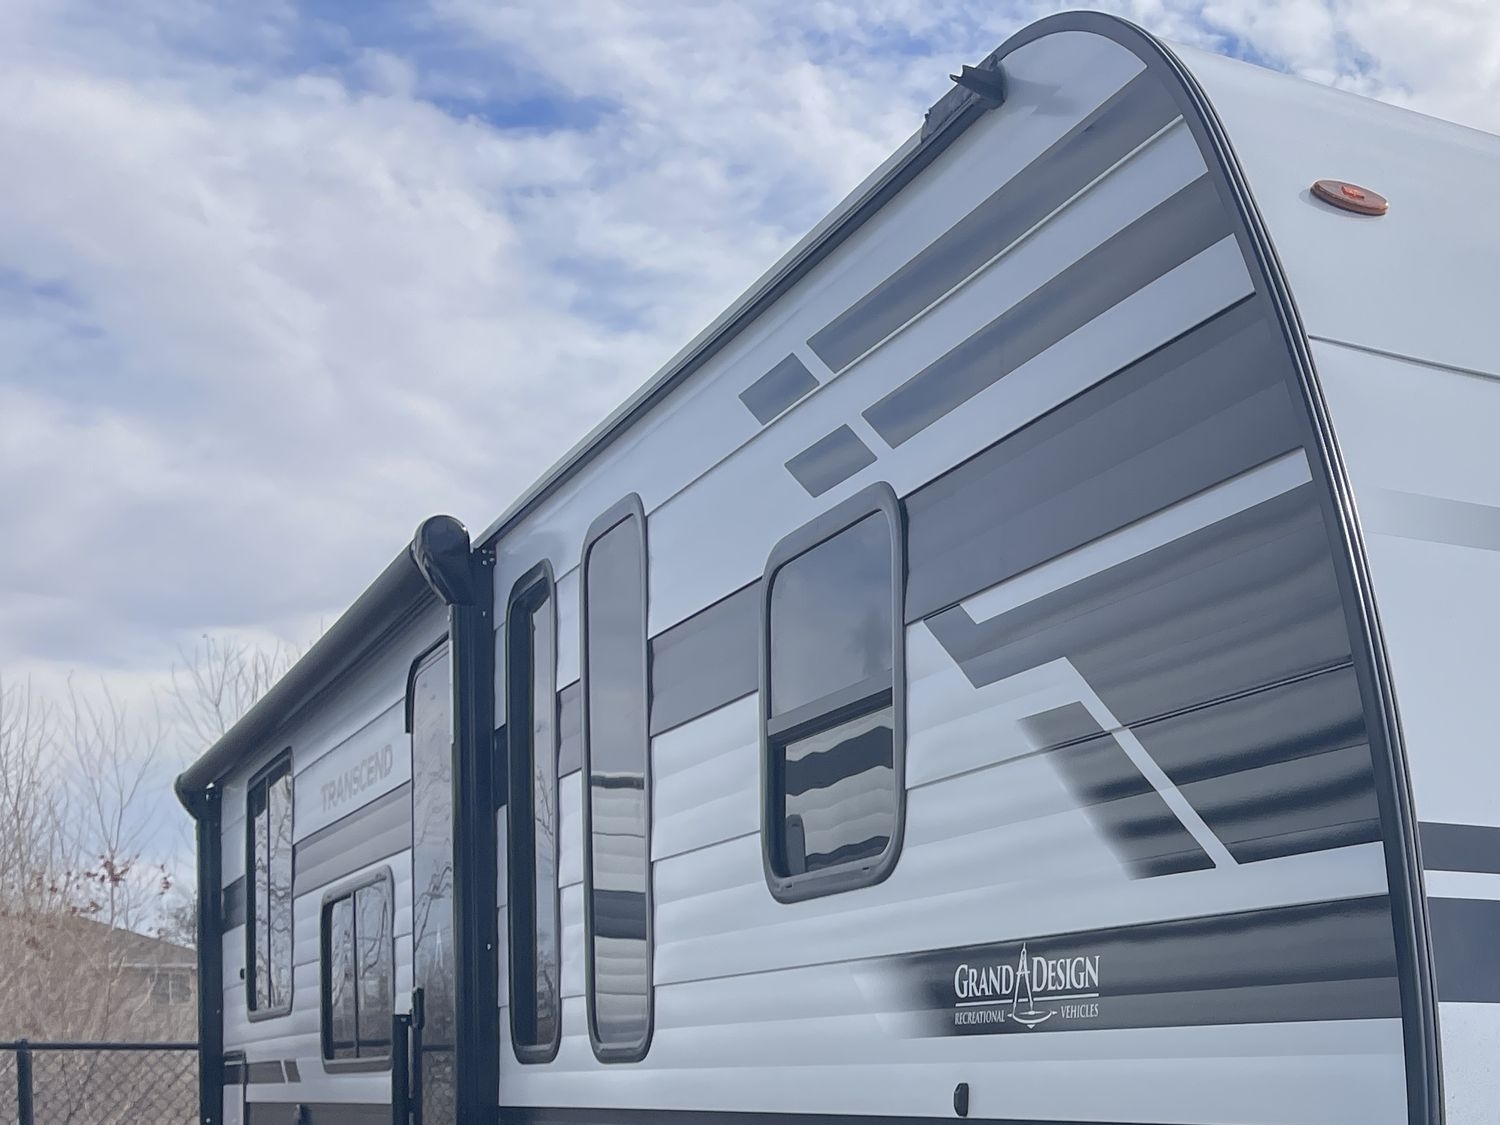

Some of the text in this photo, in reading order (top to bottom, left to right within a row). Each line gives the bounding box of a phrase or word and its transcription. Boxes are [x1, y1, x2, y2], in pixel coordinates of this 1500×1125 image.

[321, 744, 393, 813] TRANSCEND
[954, 955, 1100, 998] GRAND DESIGN
[954, 1004, 1099, 1025] RECREATIONAL VEHICLES
